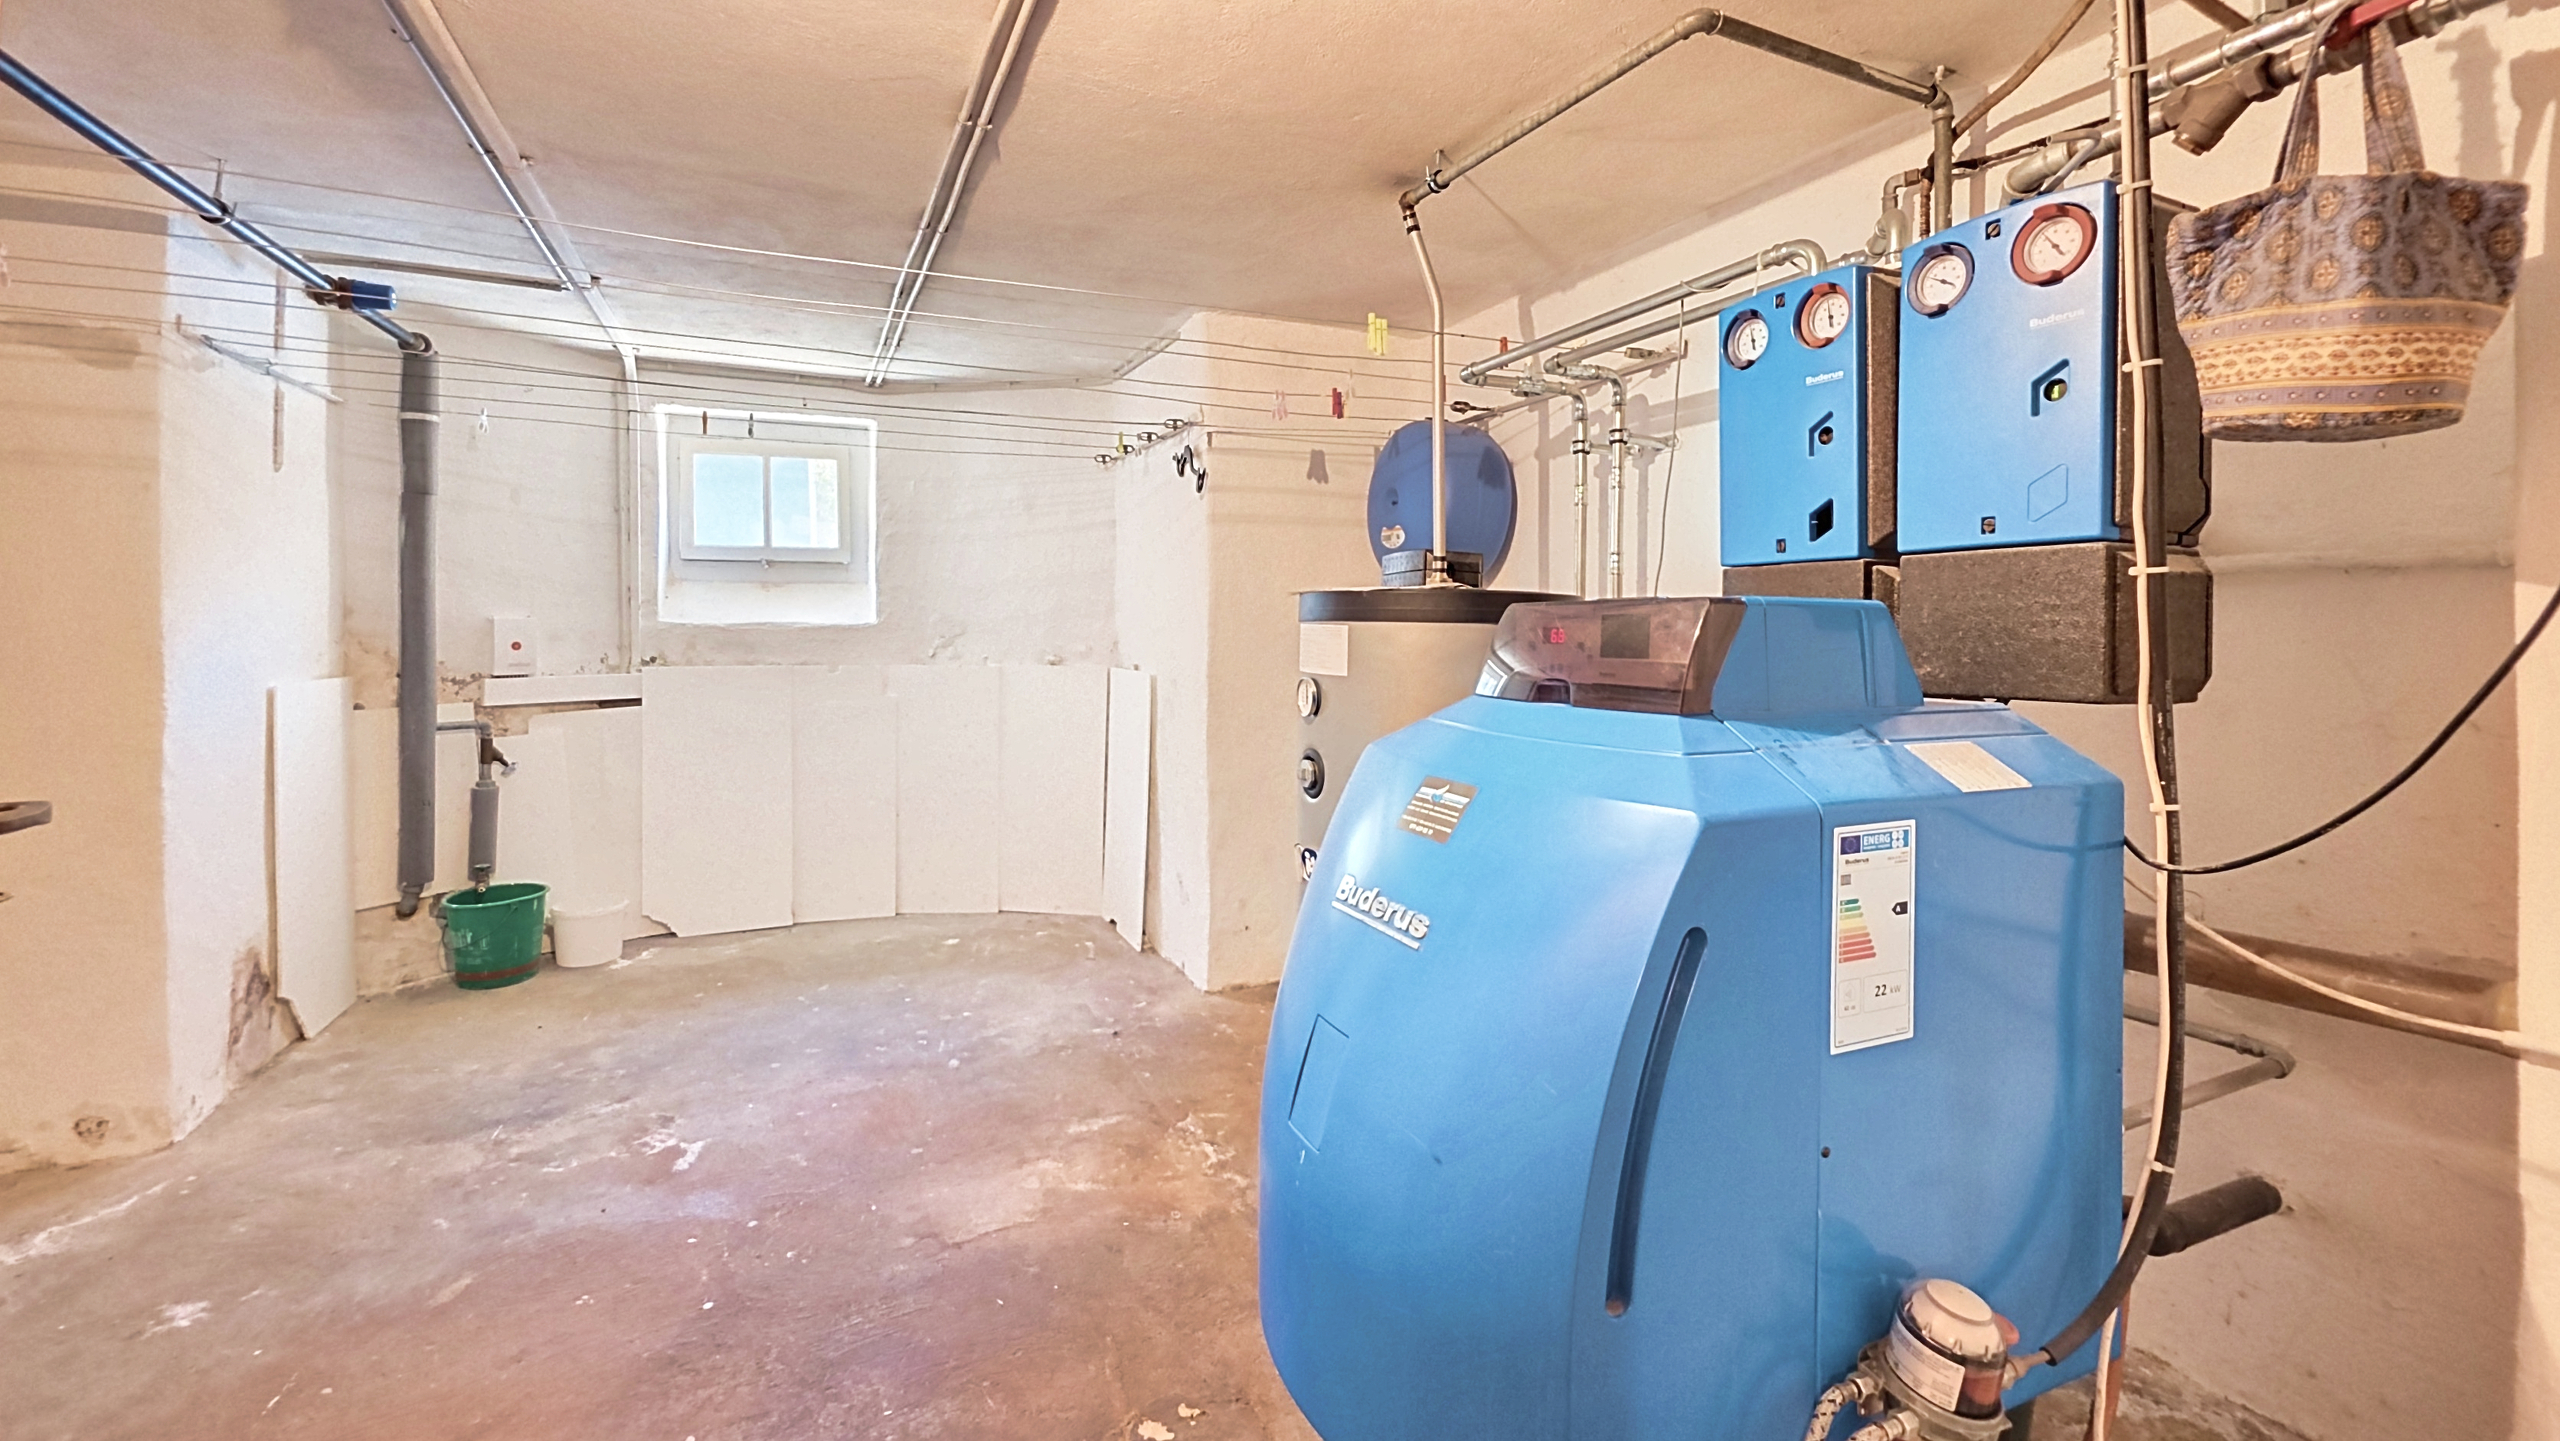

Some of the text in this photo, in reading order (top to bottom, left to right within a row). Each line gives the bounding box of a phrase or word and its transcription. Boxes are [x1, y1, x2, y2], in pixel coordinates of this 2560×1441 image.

[2030, 308, 2085, 327] Buderus
[1806, 370, 1844, 385] Buderus
[1863, 833, 1891, 846] ENERG
[1335, 873, 1430, 939] Buderus
[1895, 905, 1901, 913] A
[1875, 984, 1901, 998] 22 kW
